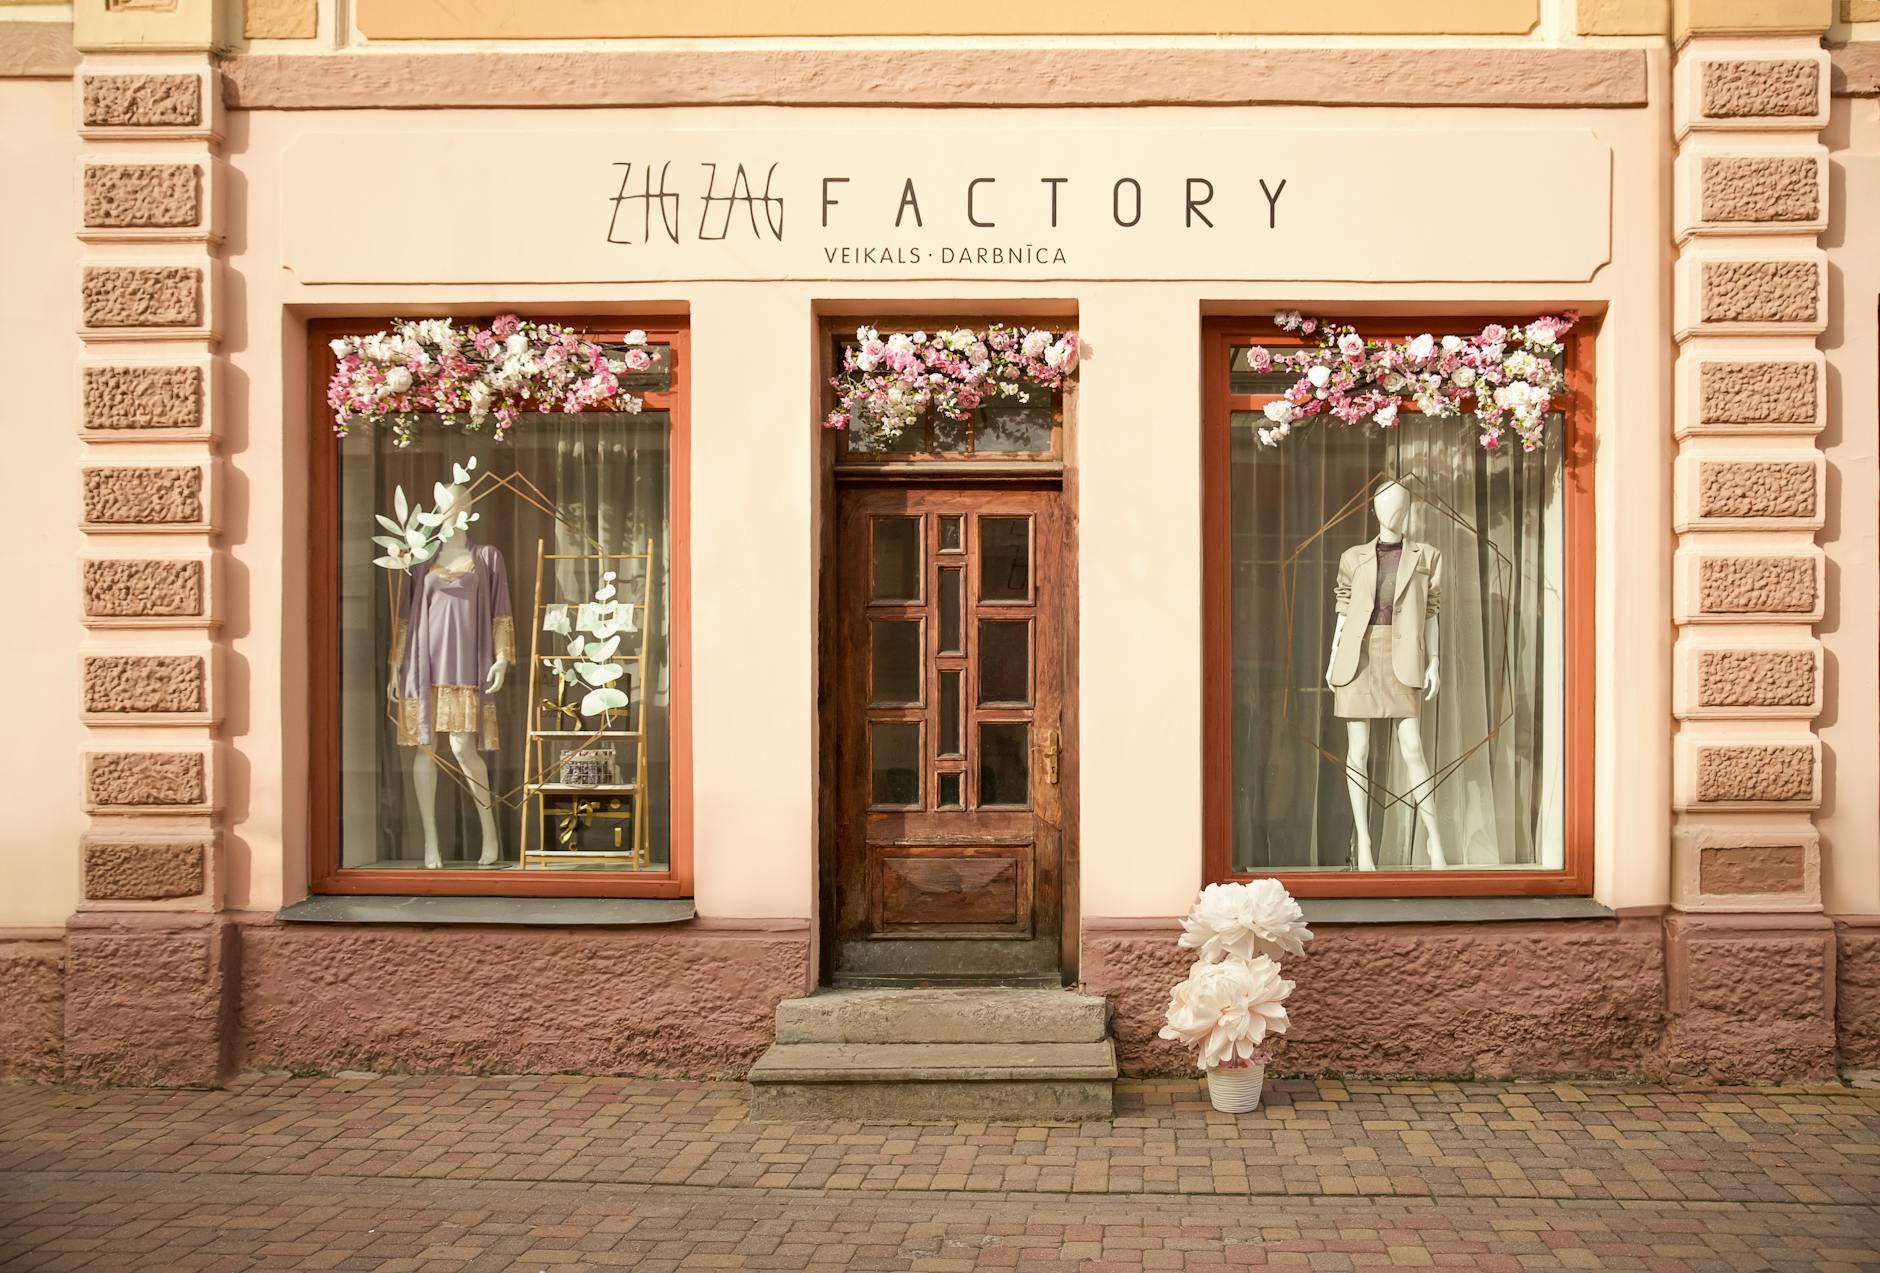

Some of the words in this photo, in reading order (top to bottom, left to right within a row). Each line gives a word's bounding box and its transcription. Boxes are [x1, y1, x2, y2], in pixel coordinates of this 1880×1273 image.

[607, 161, 680, 244] ZIG
[699, 162, 784, 242] ZAG
[822, 177, 1287, 229] FACTORY
[824, 247, 922, 264] VEIKALS
[942, 243, 1067, 264] DARBNĪCA
